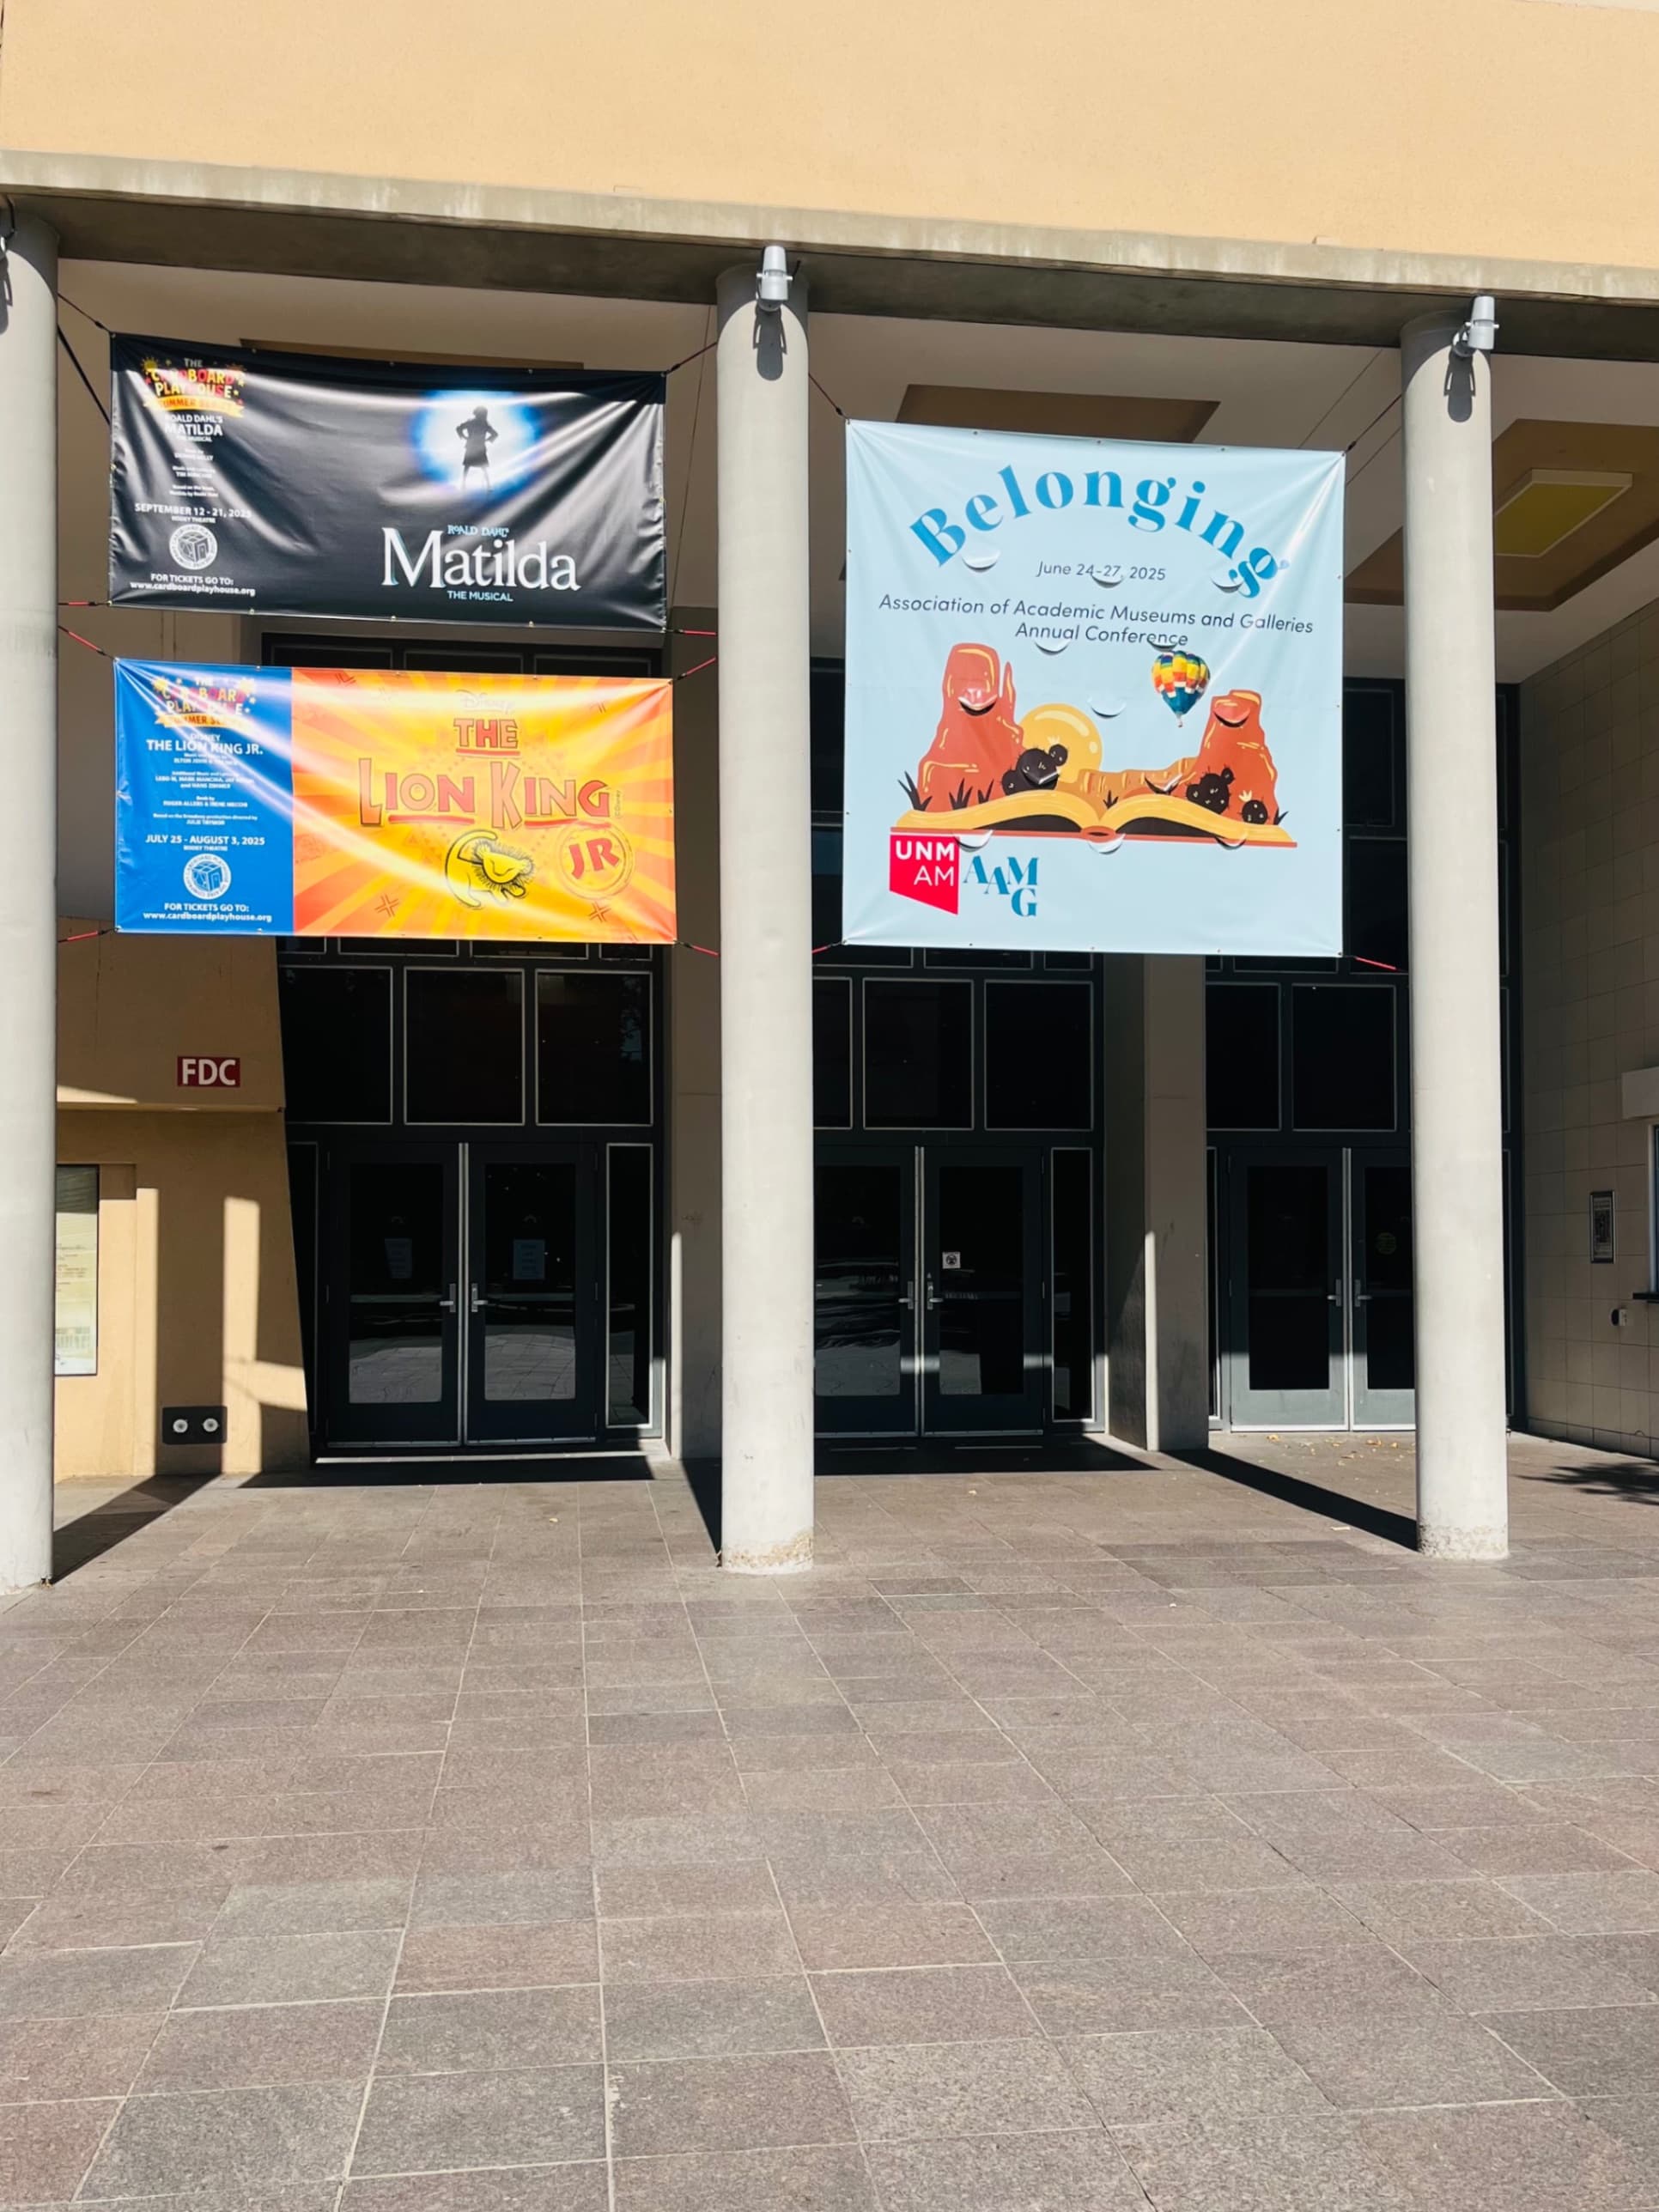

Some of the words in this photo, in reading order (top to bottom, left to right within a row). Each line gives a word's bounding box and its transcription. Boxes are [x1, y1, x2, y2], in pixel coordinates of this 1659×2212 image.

[183, 357, 203, 368] THE
[151, 368, 235, 385] CDBOARD
[155, 381, 233, 398] PLAYOUSE
[165, 414, 192, 422] OALD
[165, 423, 222, 436] MATILDA
[135, 503, 191, 514] SEPTEMBER
[212, 508, 227, 518] 21,
[447, 525, 477, 535] ROALD
[909, 465, 1289, 599] Belonging
[381, 527, 581, 591] Matilda
[150, 573, 168, 581] FOR
[170, 574, 204, 584] TICKETS
[205, 575, 218, 584] GO
[220, 576, 234, 585] TO:
[1036, 561, 1071, 578] June
[1130, 566, 1166, 581] 2025
[131, 581, 256, 596] www.cardboardplayhouse.org
[447, 590, 467, 599] THE
[469, 592, 514, 602] MUSICAL
[878, 593, 984, 614] Association
[990, 599, 1011, 614] of
[1013, 600, 1105, 619] Academic
[1110, 605, 1196, 625] Museums
[1201, 613, 1235, 629] and
[1240, 613, 1314, 634] Galleries
[1015, 622, 1079, 640] Annual
[1085, 624, 1188, 647] Conference
[162, 686, 246, 703] CBOARD
[453, 718, 520, 750] THE
[146, 739, 173, 751] THE
[175, 739, 207, 752] LION
[210, 742, 242, 755] KING
[246, 743, 264, 756] JR.
[358, 758, 475, 827] LION
[490, 762, 611, 830] KING
[145, 835, 168, 843] JULY
[170, 835, 182, 844] 25
[190, 836, 229, 845] AUGUST
[231, 836, 240, 846] 3,
[242, 836, 265, 846] 2025
[568, 837, 619, 879] JR
[896, 840, 955, 861] UNM
[914, 865, 955, 887] AM
[164, 902, 182, 911] FOR
[184, 903, 218, 912] TICKETS
[143, 912, 272, 923] www.cardboardplayhouse.org
[182, 1058, 236, 1085] FDC
